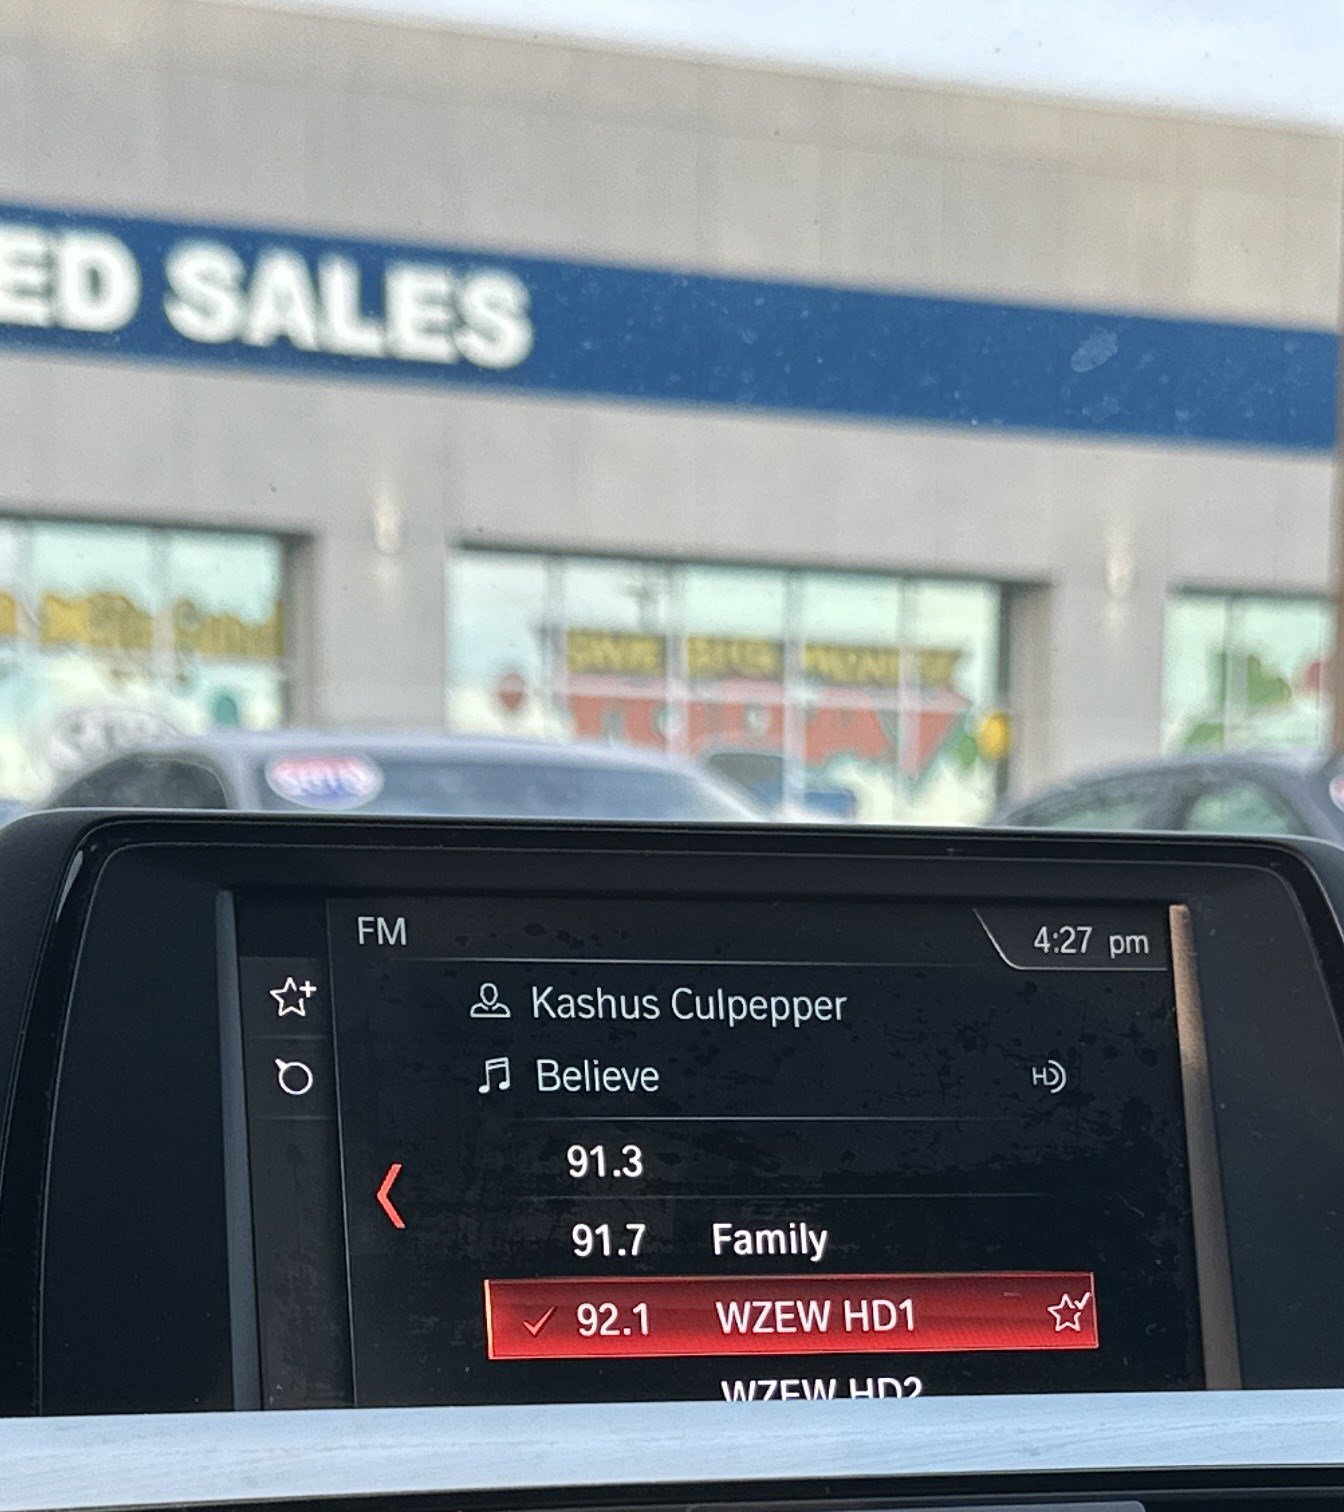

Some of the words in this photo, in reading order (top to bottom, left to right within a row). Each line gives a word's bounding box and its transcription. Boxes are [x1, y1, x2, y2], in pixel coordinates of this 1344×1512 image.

[165, 239, 532, 369] SALES
[357, 916, 407, 946] FM
[1033, 925, 1093, 954] 4:27
[1109, 931, 1149, 959] pm
[532, 985, 660, 1020] Kashus
[671, 987, 847, 1028] Culpepper
[536, 1058, 660, 1092] Believe
[566, 1144, 643, 1178] 91.3
[572, 1223, 646, 1257] 91.7
[712, 1222, 828, 1262] Family
[577, 1302, 650, 1337] 92.1
[716, 1299, 831, 1335] WZEW
[843, 1298, 915, 1332] HD1
